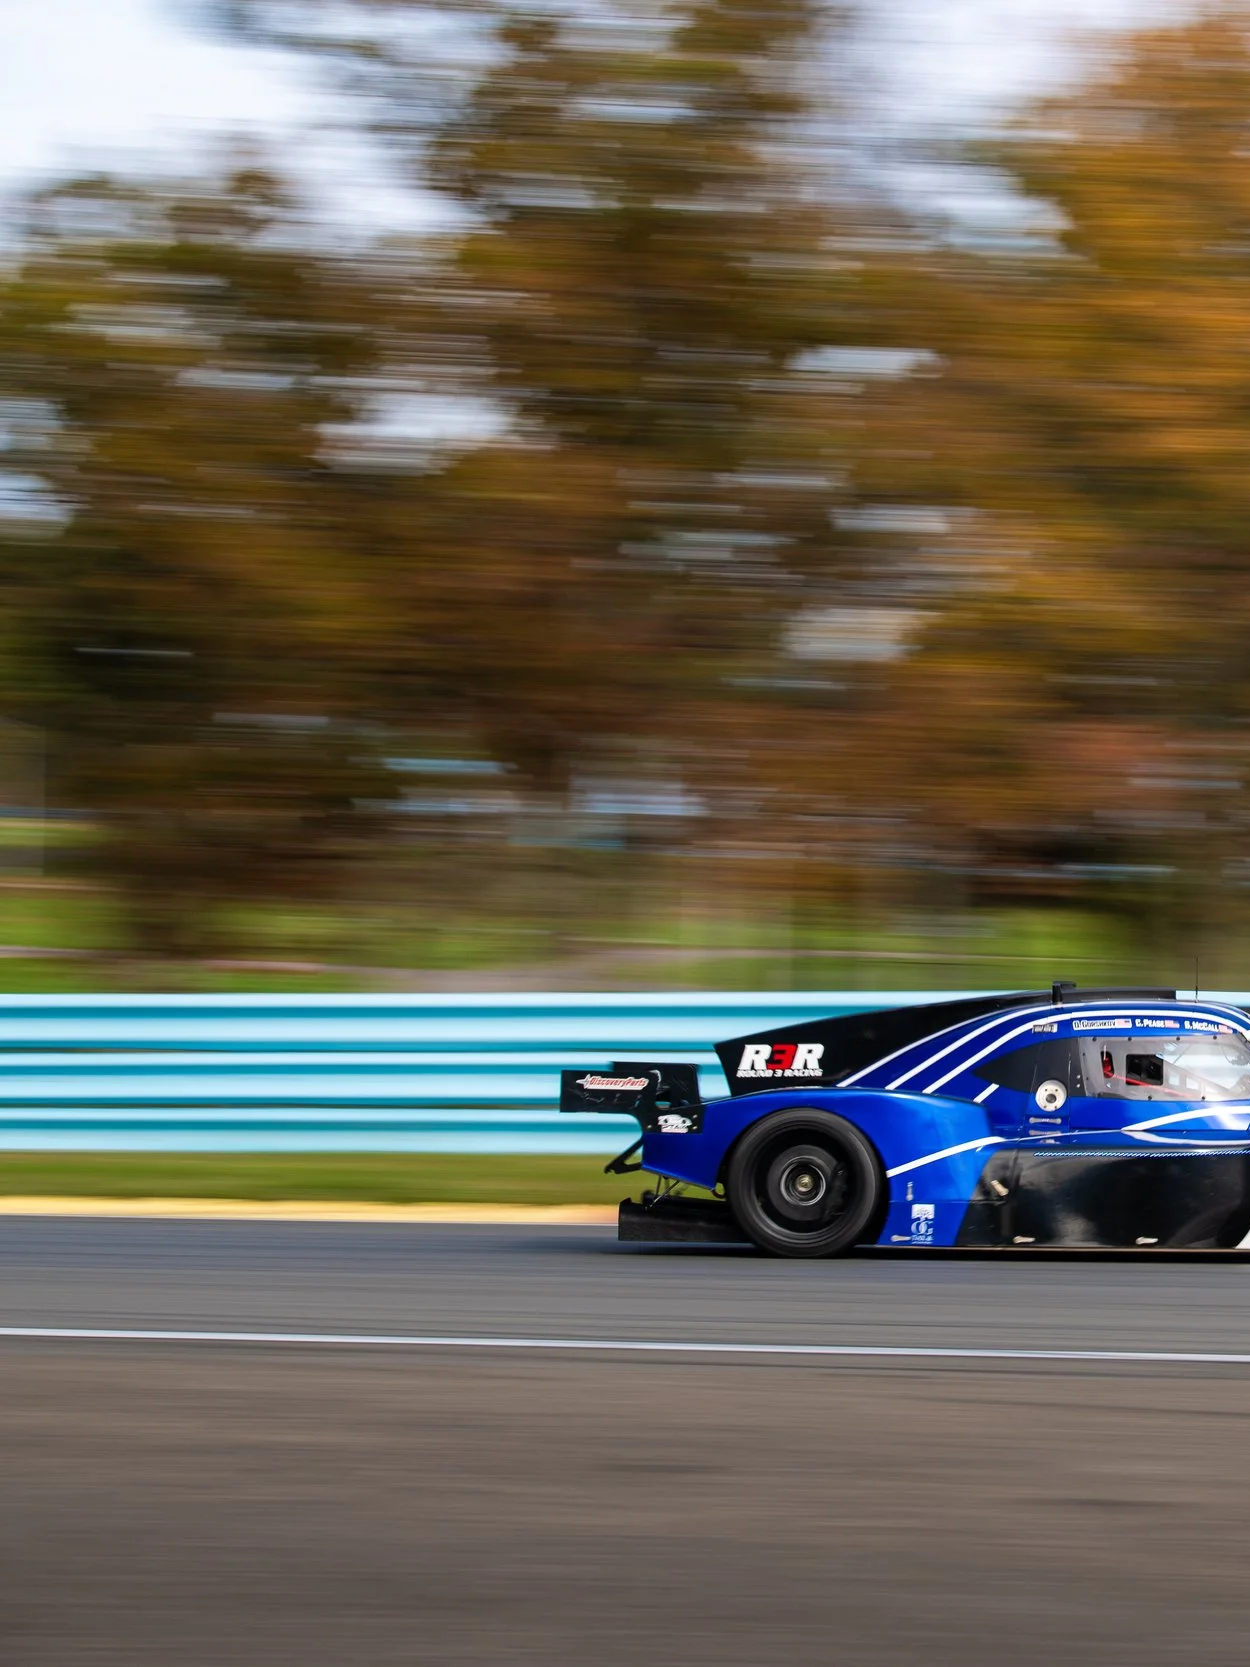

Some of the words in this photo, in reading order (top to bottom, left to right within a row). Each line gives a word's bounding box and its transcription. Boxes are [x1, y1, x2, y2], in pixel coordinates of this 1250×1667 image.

[738, 1043, 825, 1070] R3R
[774, 1069, 783, 1077] 3
[784, 1068, 823, 1077] RACING
